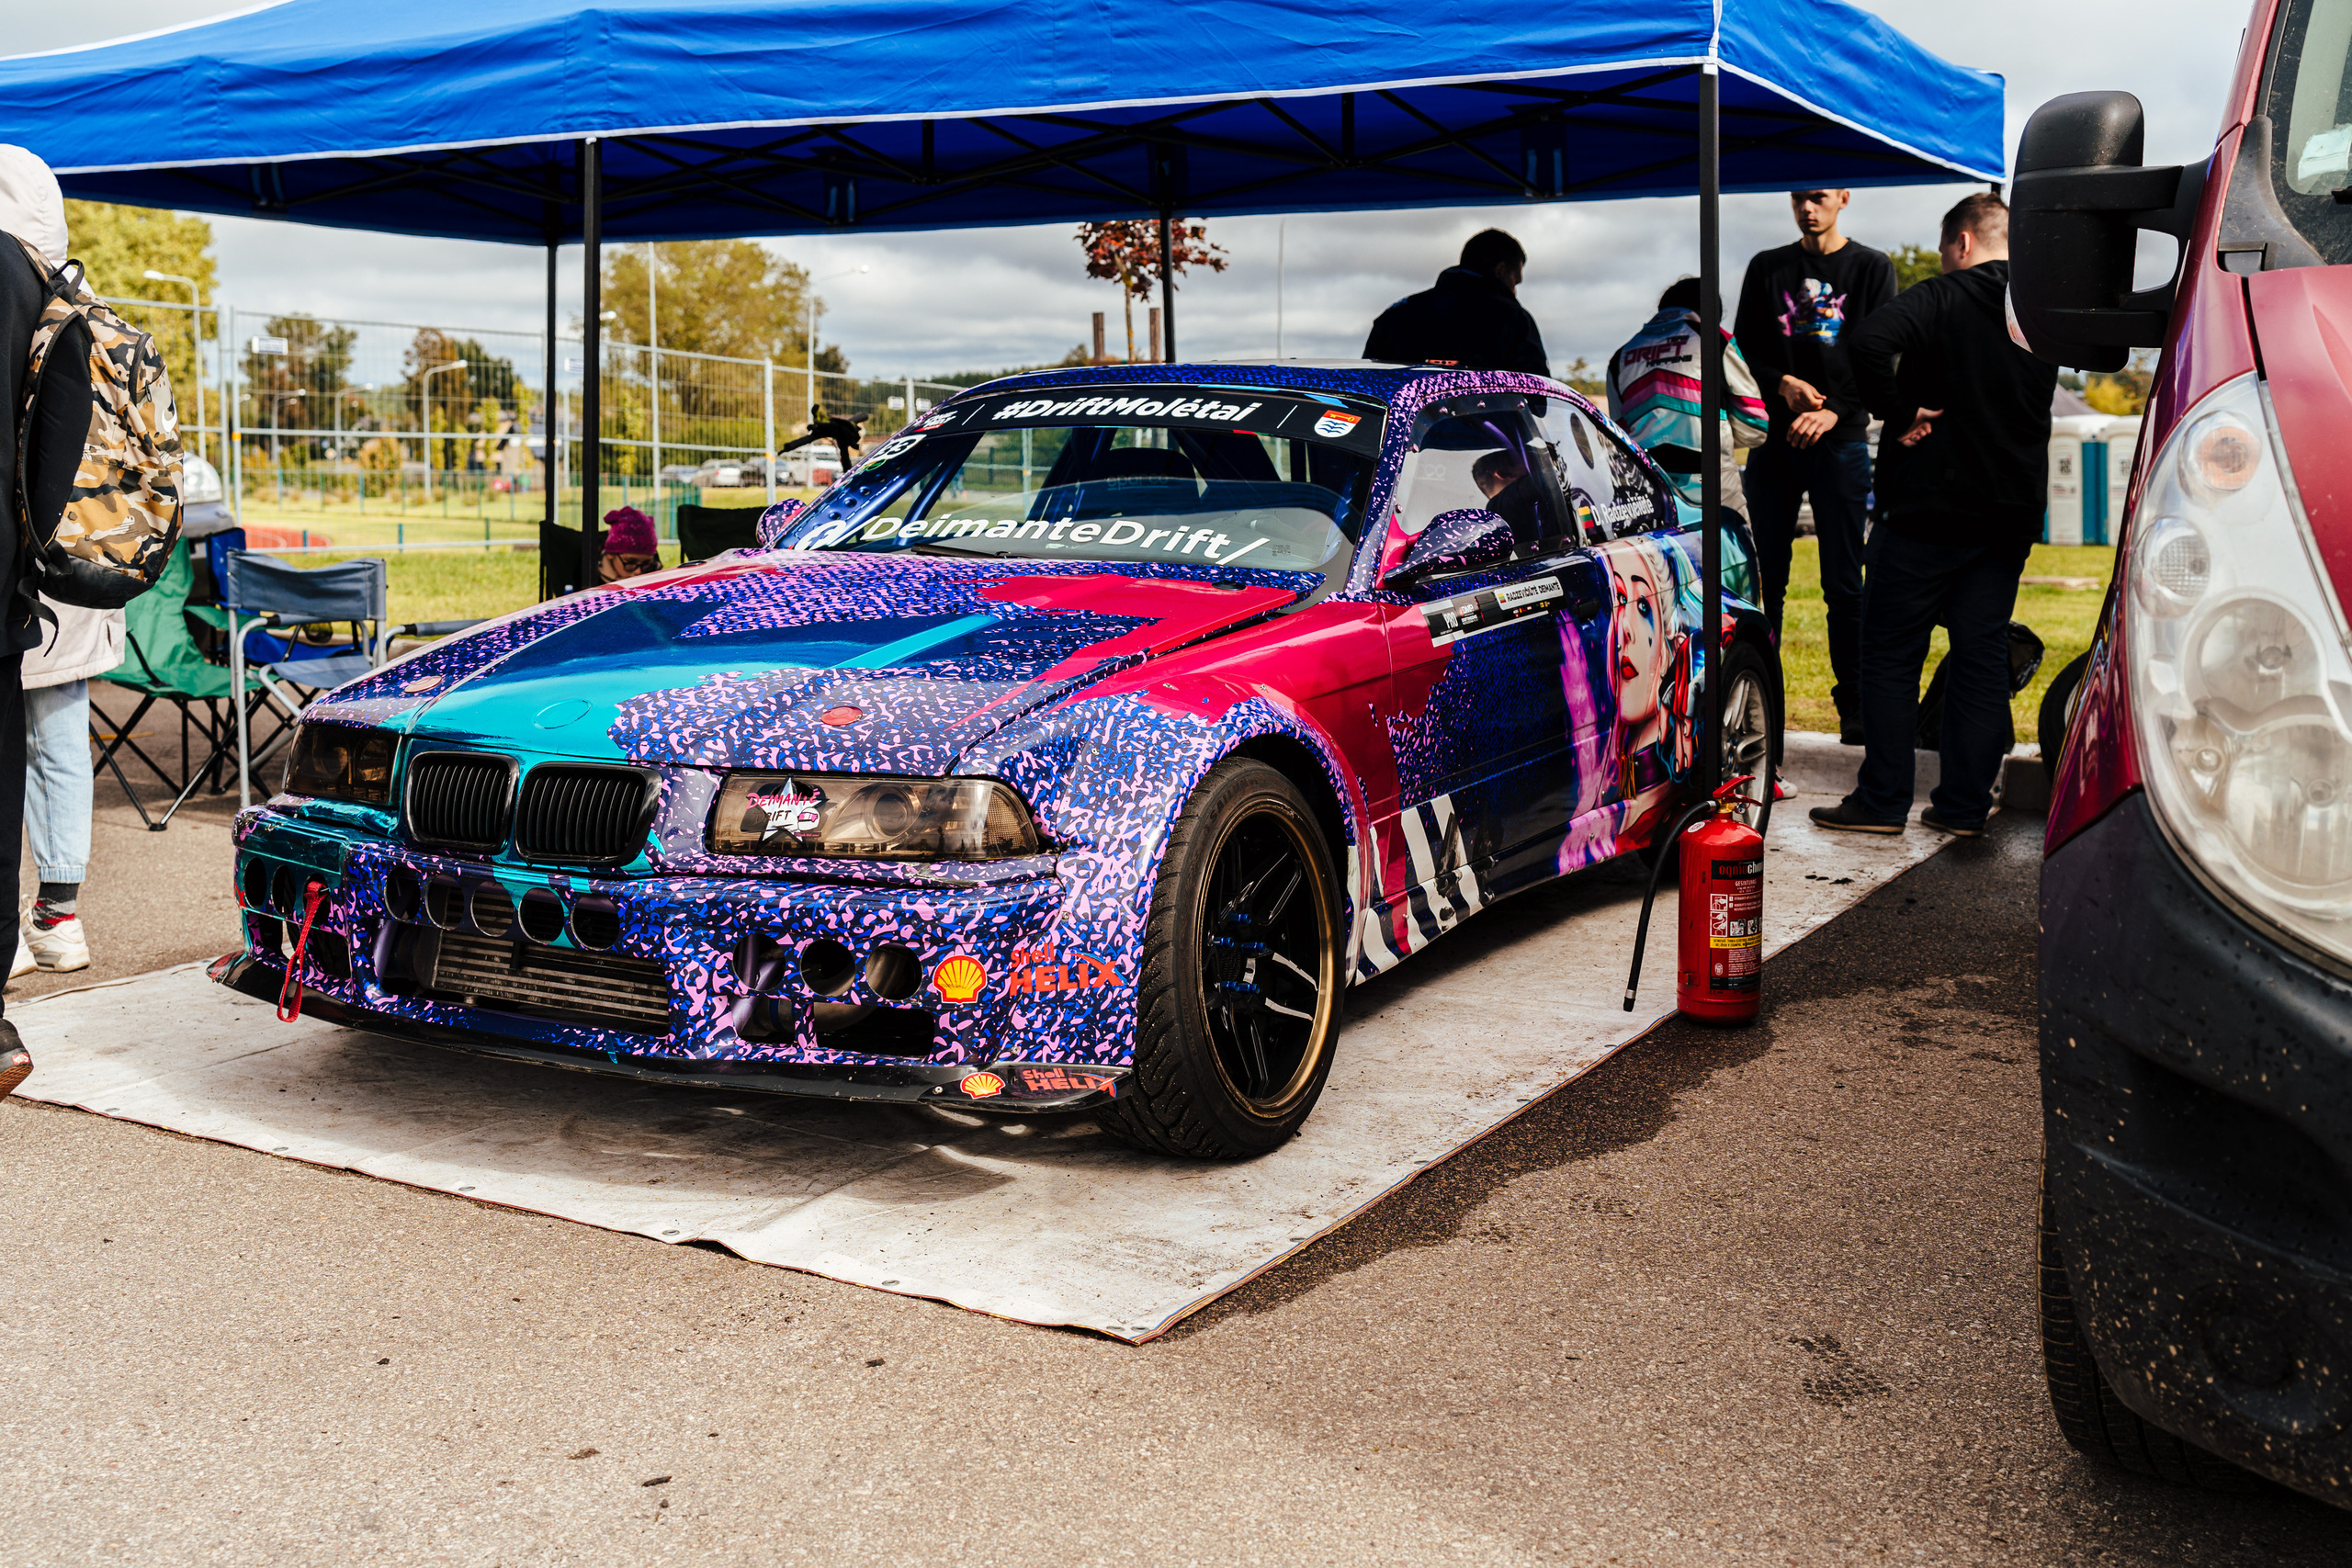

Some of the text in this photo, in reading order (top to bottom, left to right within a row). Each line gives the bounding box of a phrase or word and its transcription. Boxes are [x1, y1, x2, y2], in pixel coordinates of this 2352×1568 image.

[1624, 341, 1689, 367] DRIFT
[873, 438, 917, 459] 33
[1590, 505, 1605, 526] D.
[1443, 612, 1459, 629] PRO
[1011, 942, 1056, 967] Shell
[1009, 958, 1125, 997] HELIX
[1022, 1067, 1066, 1080] Shell
[1024, 1076, 1117, 1098] HELIX
